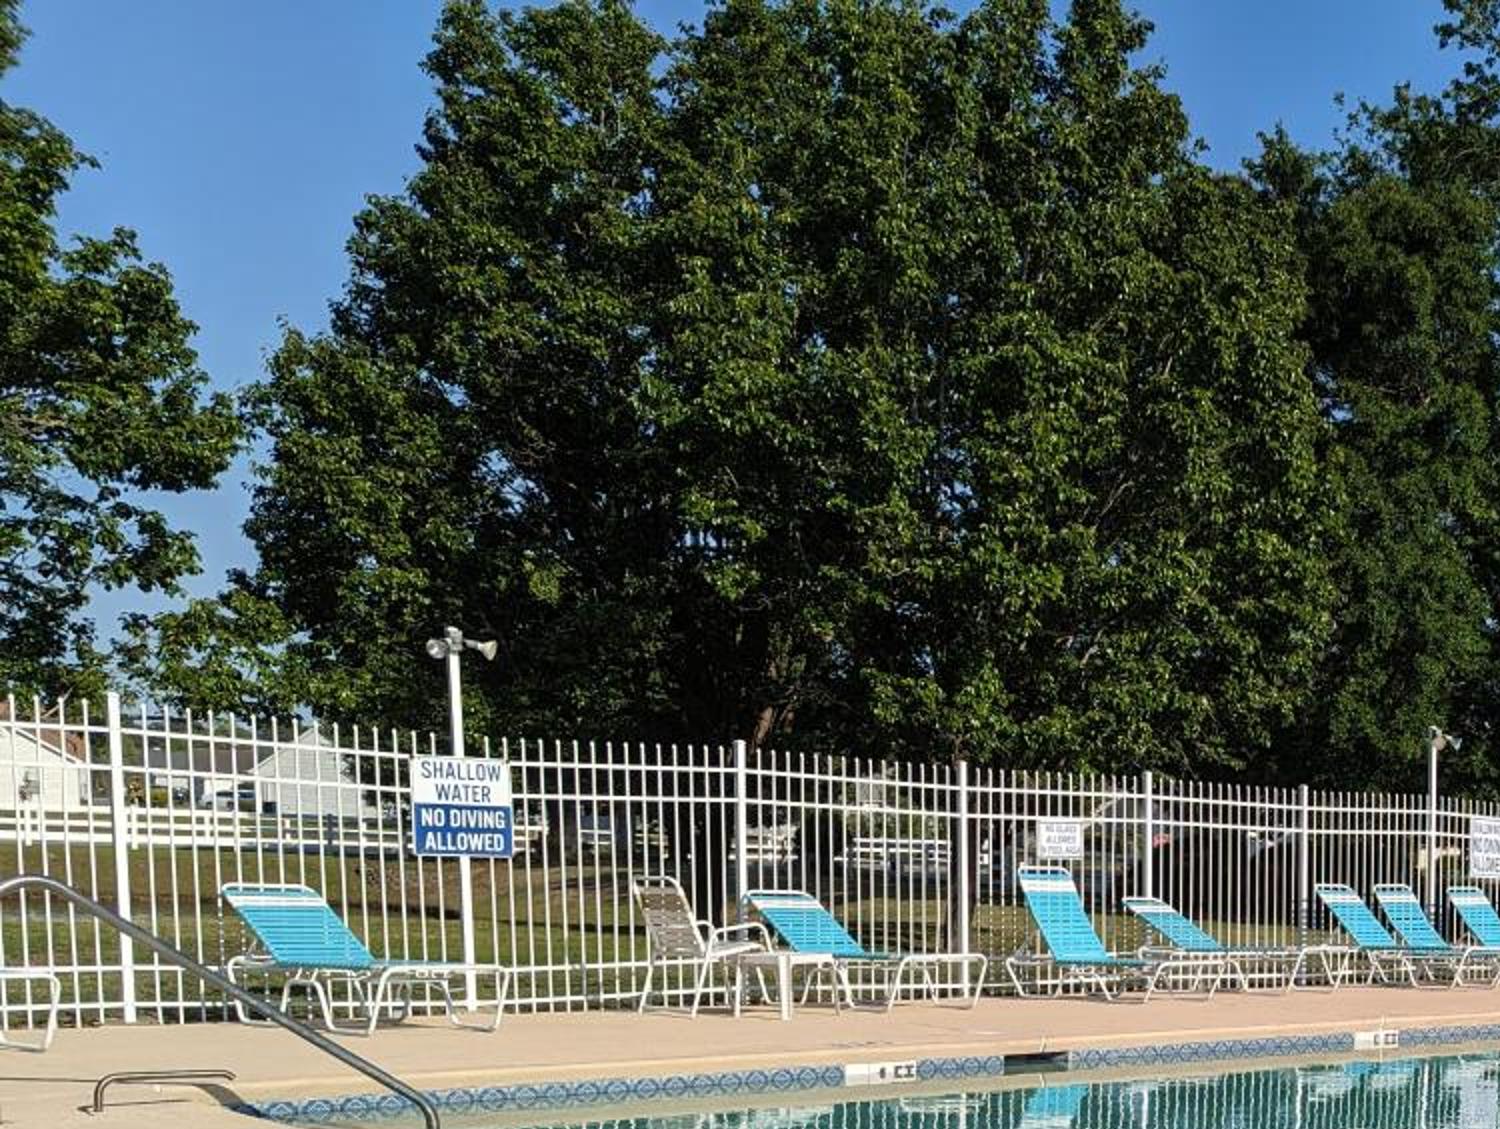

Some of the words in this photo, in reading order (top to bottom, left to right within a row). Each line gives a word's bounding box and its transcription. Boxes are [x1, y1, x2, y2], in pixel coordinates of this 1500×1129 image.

[420, 760, 501, 782] SHALLOW
[435, 783, 491, 803] WATER
[421, 807, 446, 828] NO
[449, 808, 505, 829] DIVING
[425, 831, 505, 852] ALLOWED
